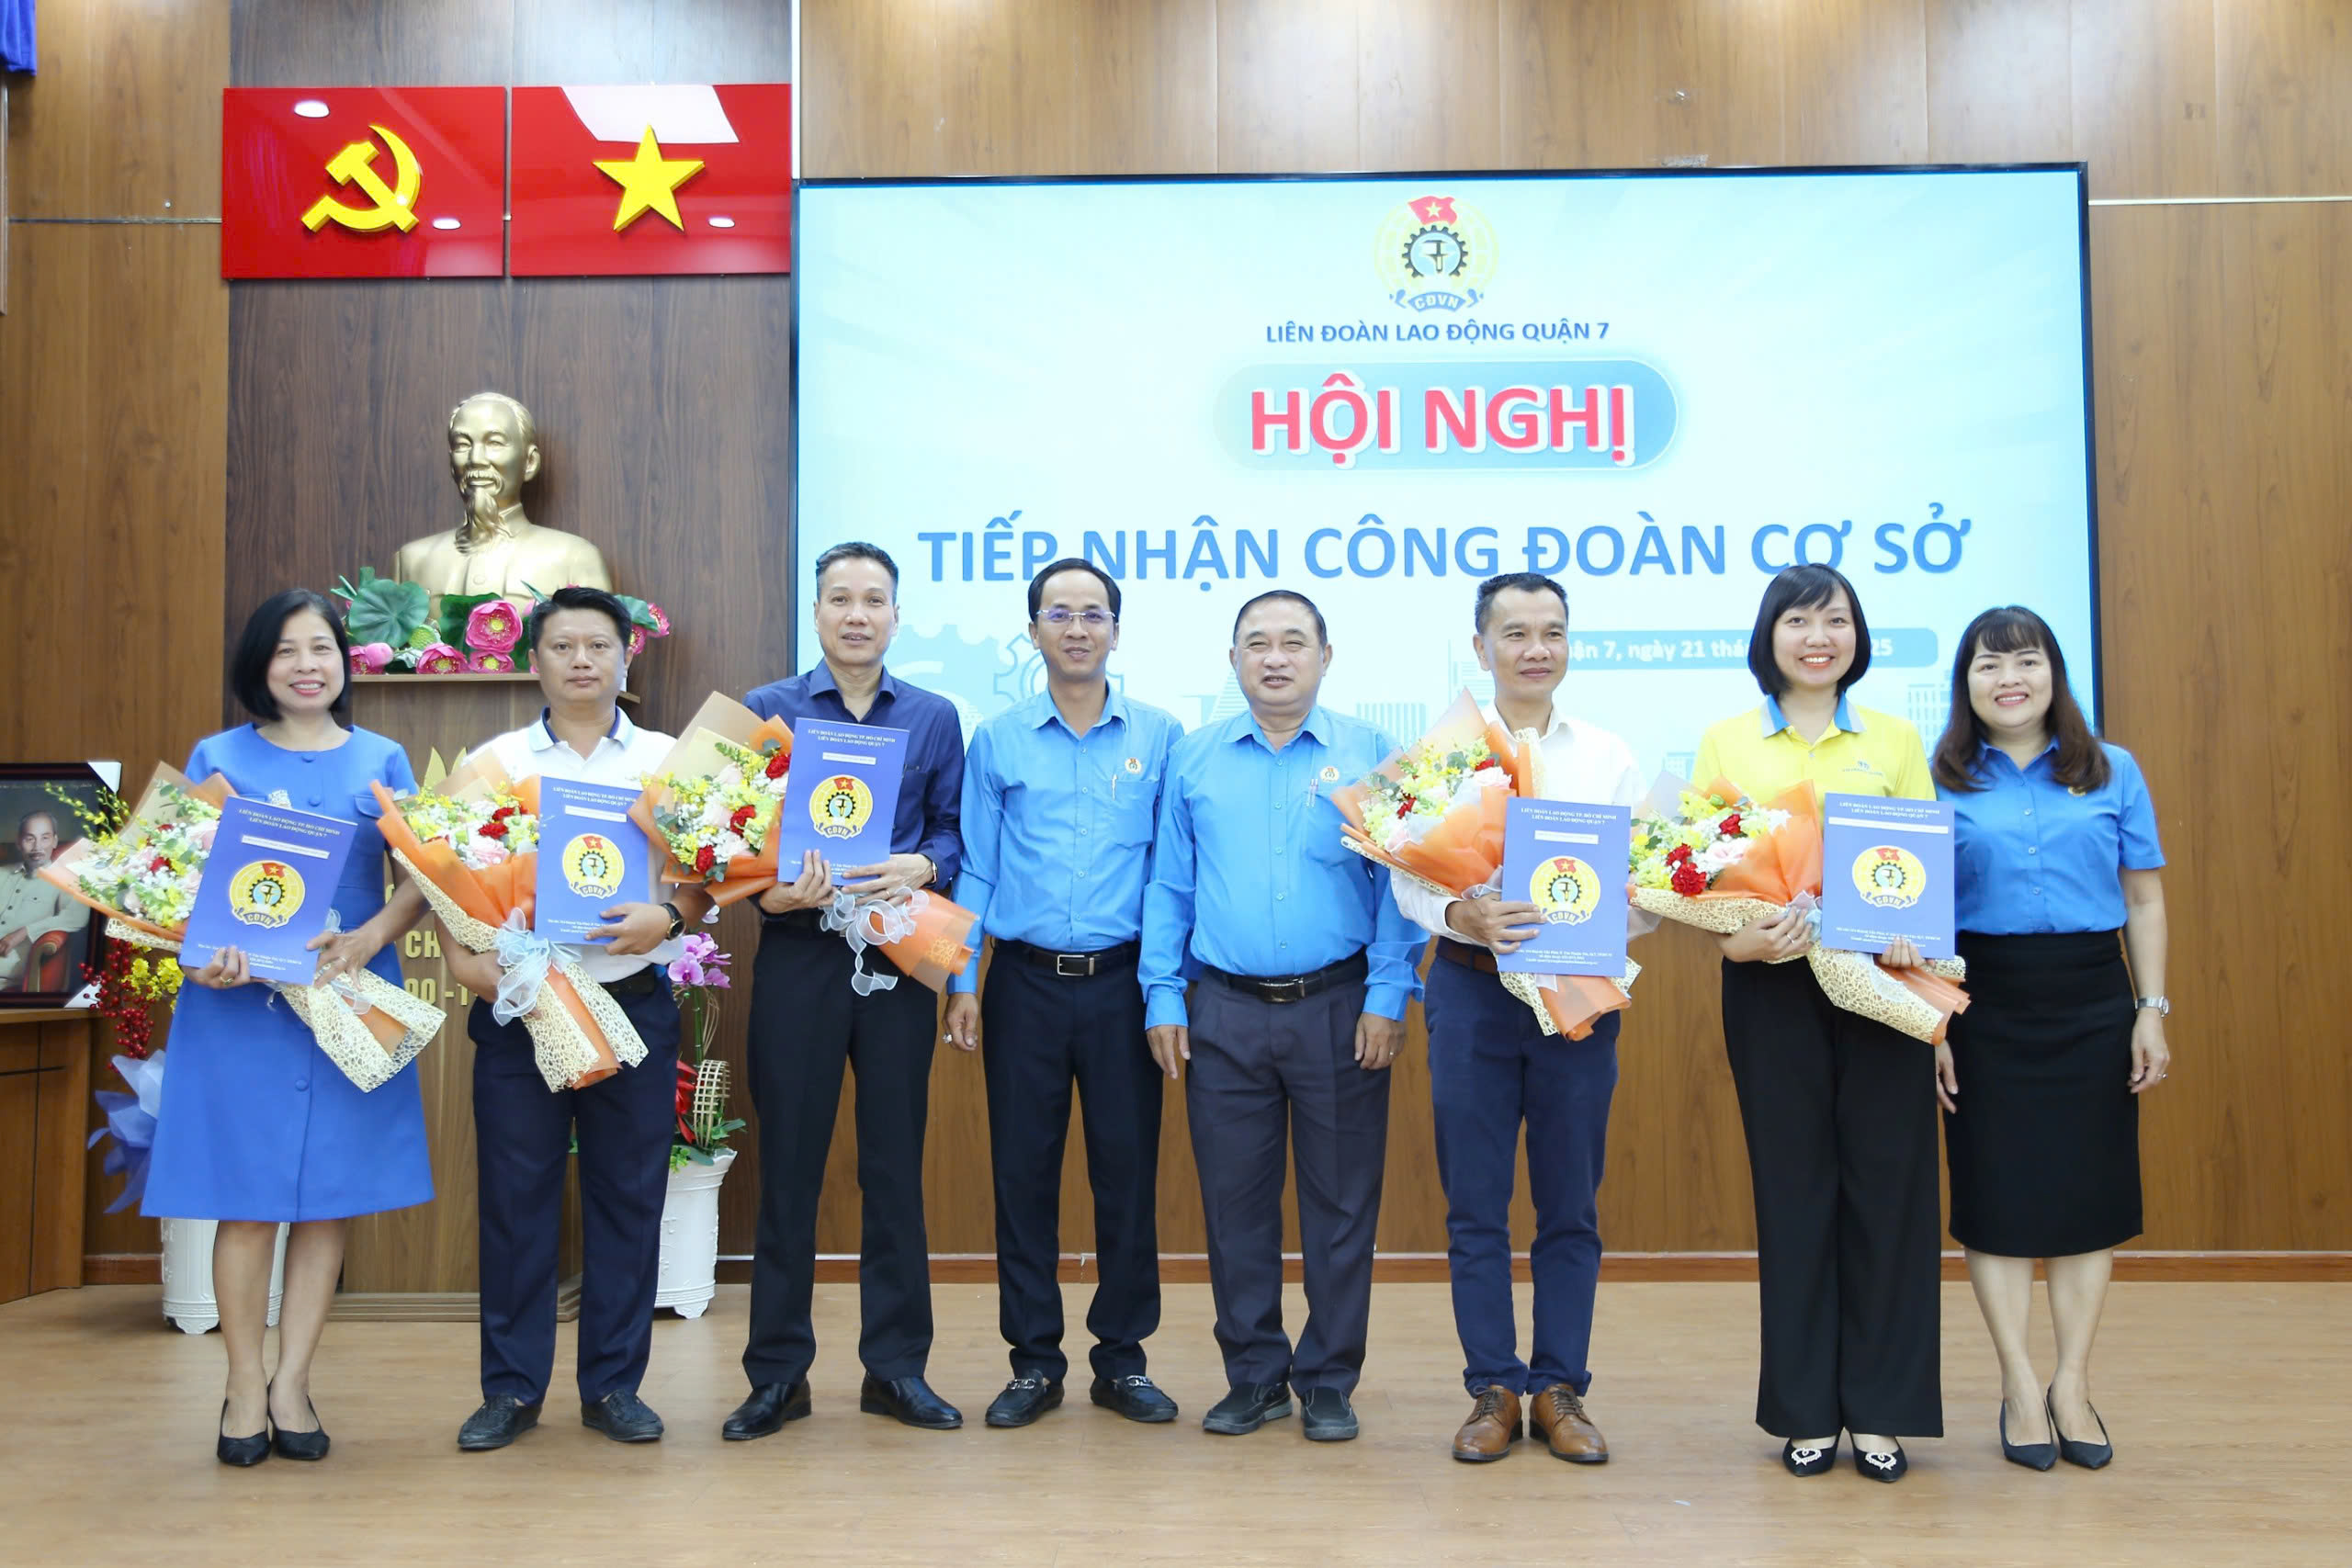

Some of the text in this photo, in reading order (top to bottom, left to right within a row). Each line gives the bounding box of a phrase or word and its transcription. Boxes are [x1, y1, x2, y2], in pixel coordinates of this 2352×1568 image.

[1266, 318, 1610, 344] LIÊN ĐOÀN LAO ĐỘNG QUẬN 7
[1251, 373, 1625, 464] HỘI NGHỊ
[918, 502, 1972, 592] TIẾP NHẬN CÔNG ĐOÀN CƠ SỞ
[1603, 640, 1622, 661] 7,
[1628, 640, 1676, 662] ngày
[1681, 640, 1705, 658] 21
